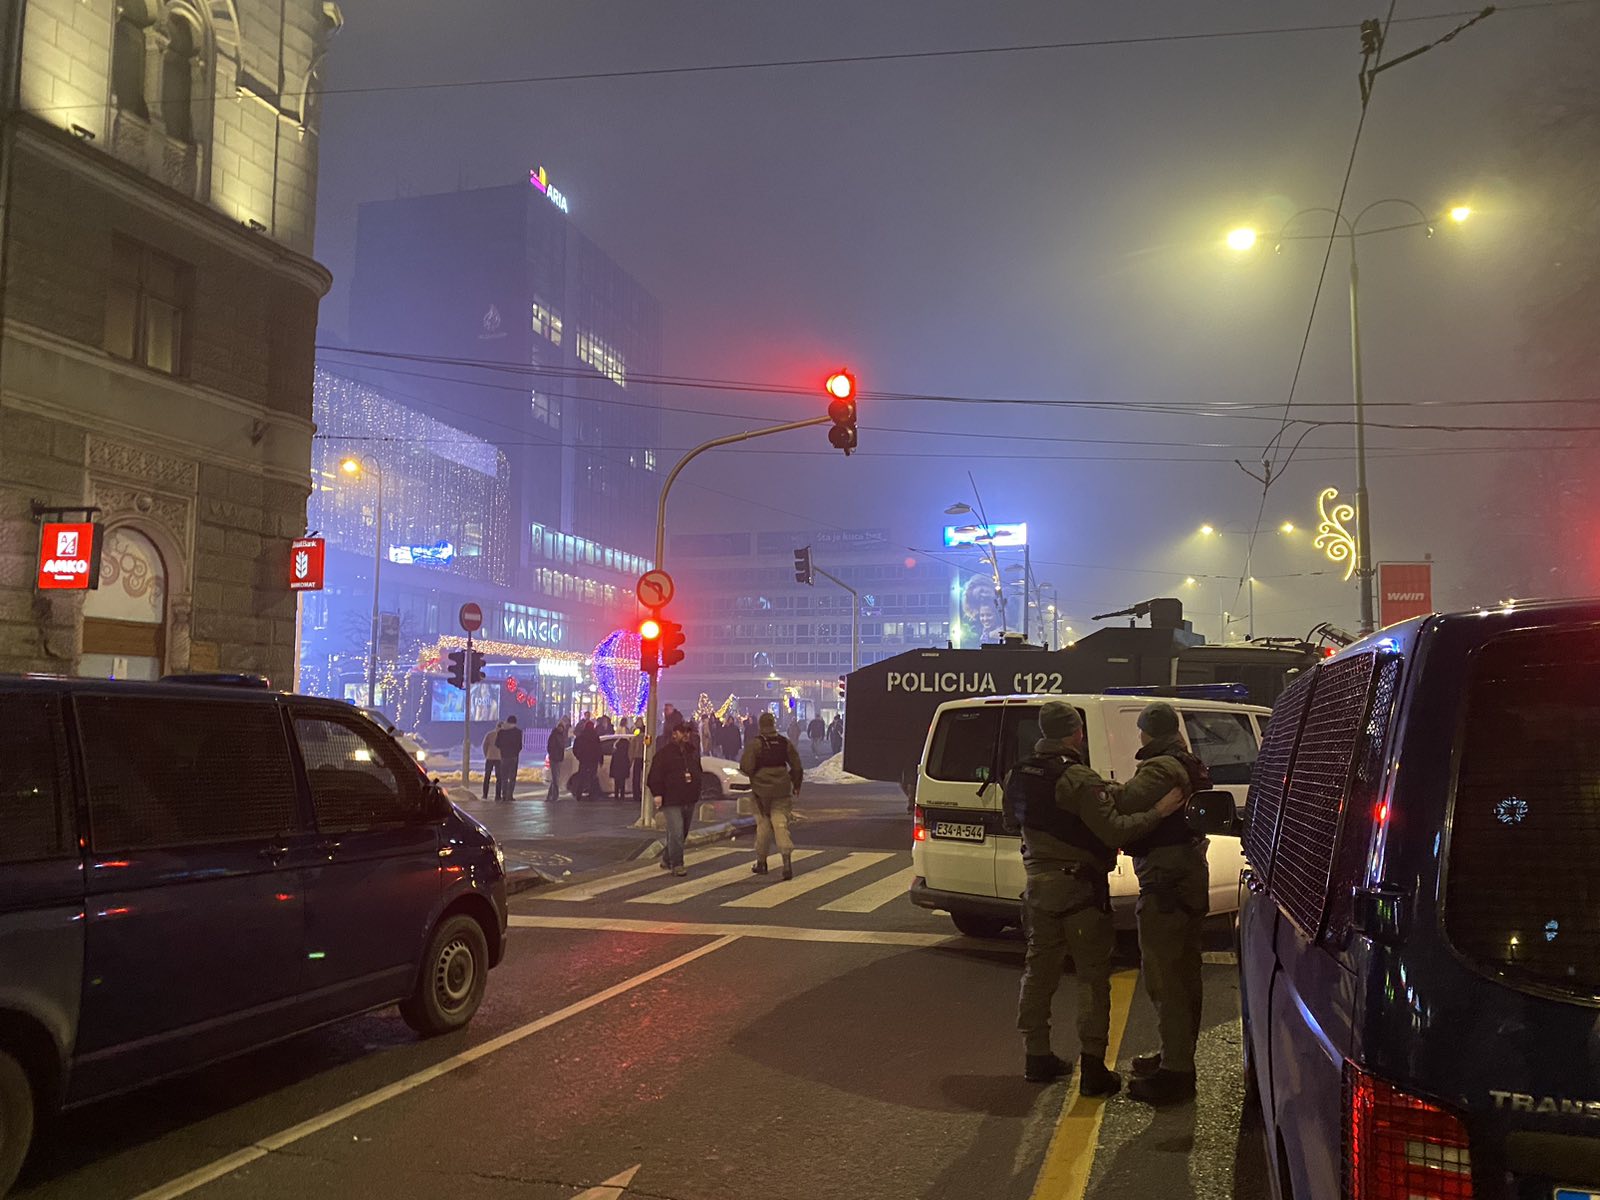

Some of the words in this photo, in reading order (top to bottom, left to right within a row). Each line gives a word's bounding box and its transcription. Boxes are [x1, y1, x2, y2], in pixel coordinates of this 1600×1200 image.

[546, 184, 568, 214] ARIA
[43, 559, 88, 574] AMKO
[503, 616, 562, 643] MANGO
[887, 672, 997, 692] POLICIJA
[1023, 672, 1063, 693] 122
[936, 823, 983, 839] E34-A-544
[1488, 1089, 1600, 1119] TRANS
